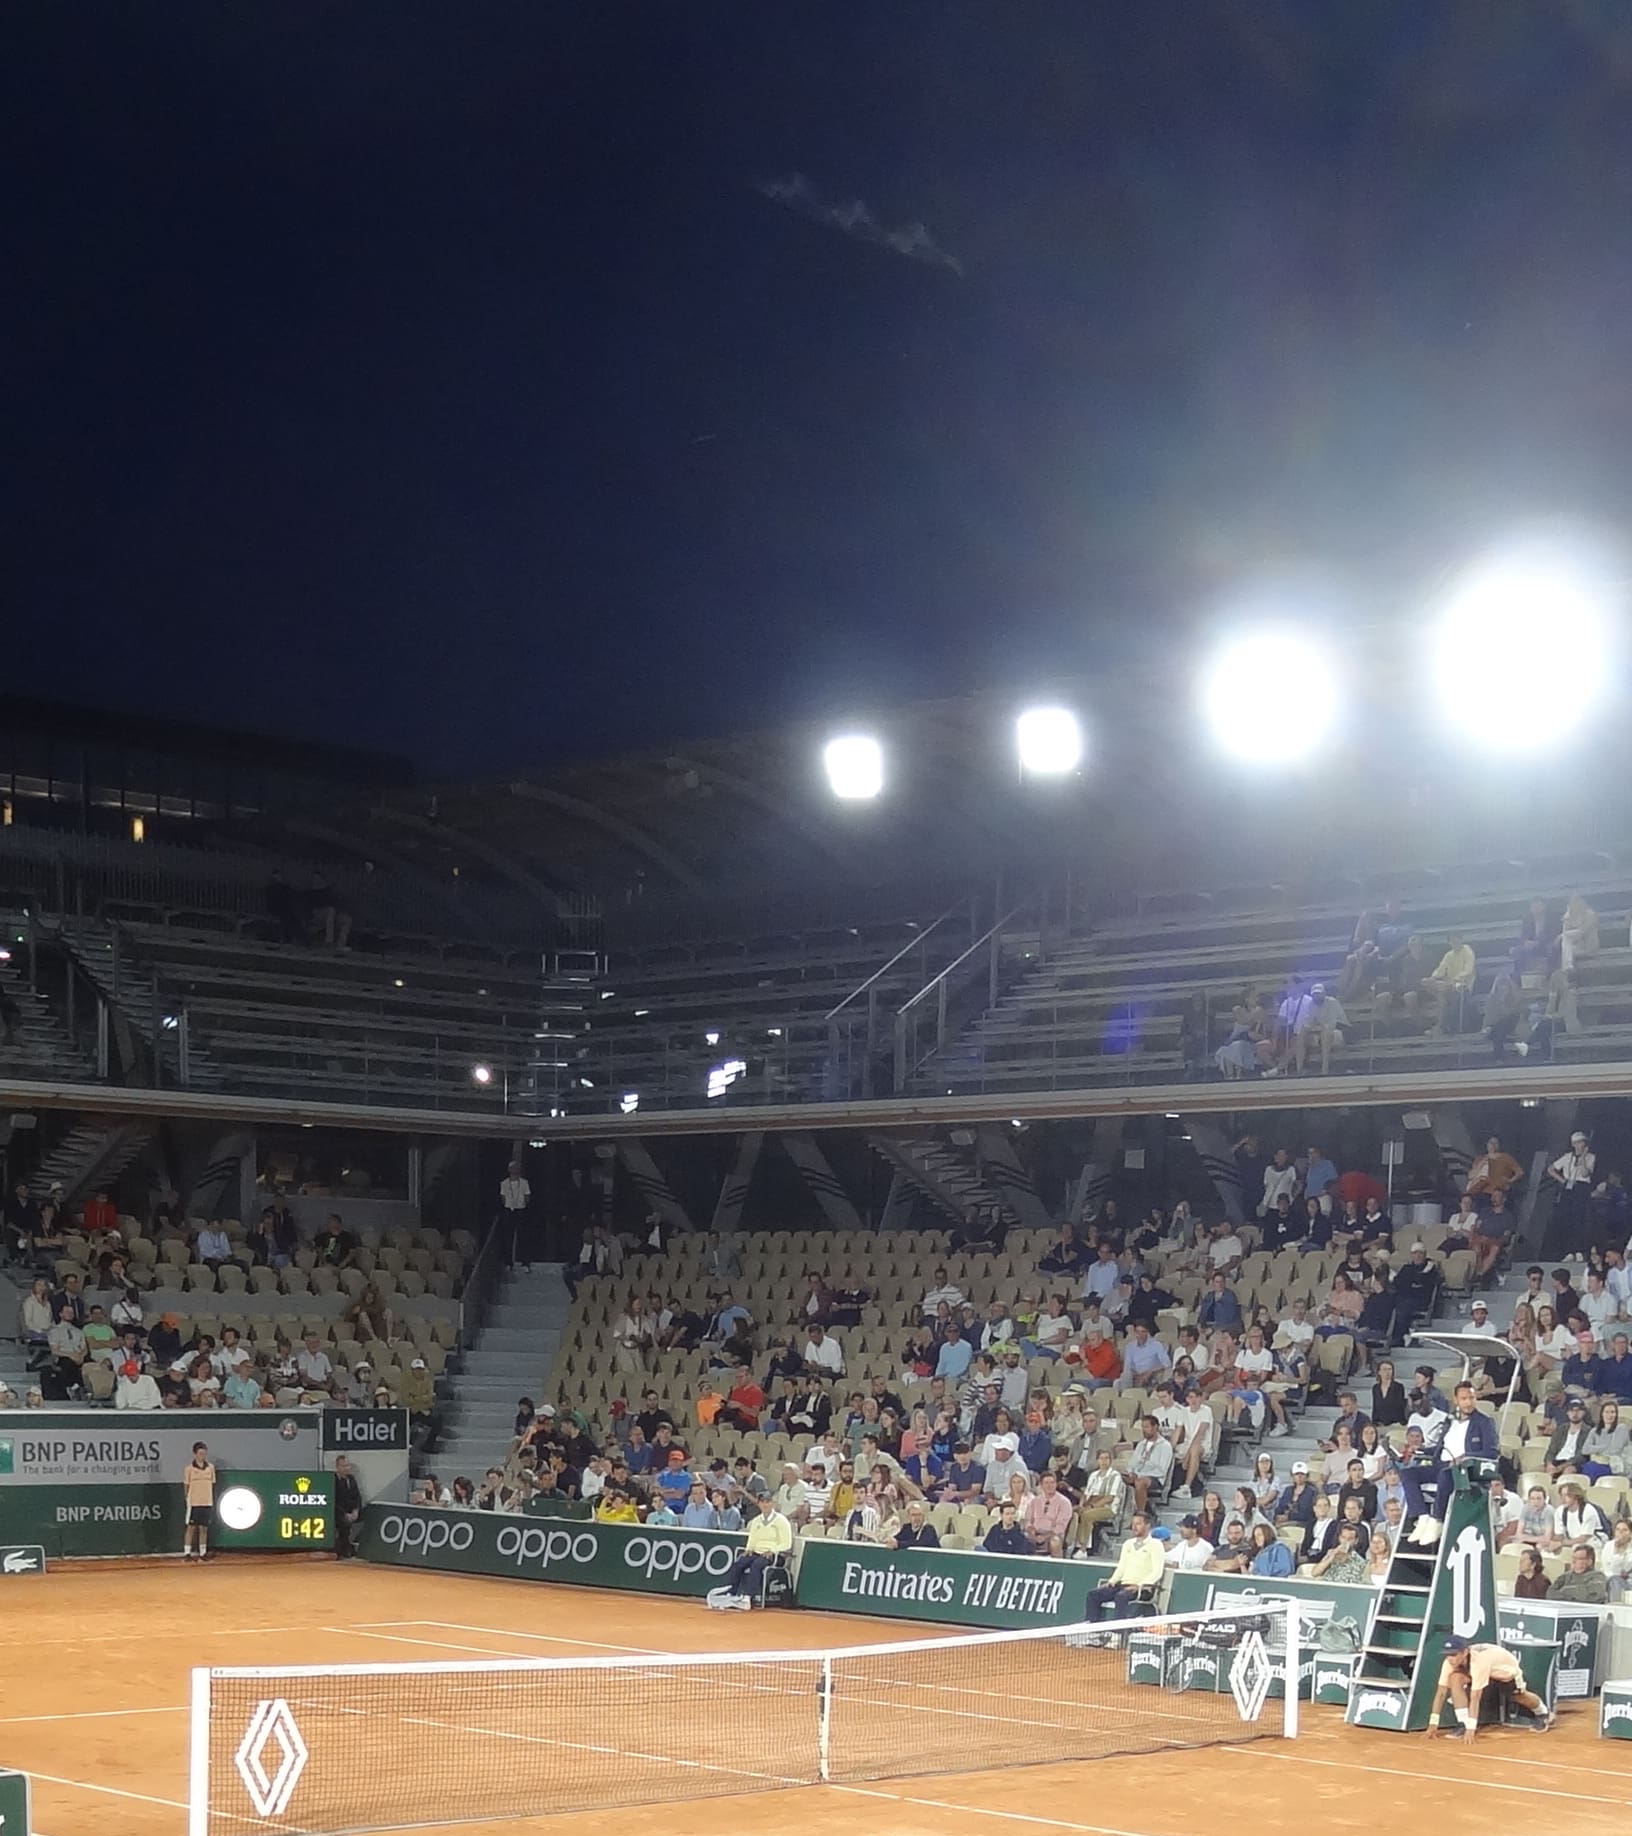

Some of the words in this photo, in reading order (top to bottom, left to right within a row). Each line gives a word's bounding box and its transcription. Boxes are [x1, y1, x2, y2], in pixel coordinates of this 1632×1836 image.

[335, 1416, 398, 1442] Haier
[22, 1442, 66, 1462] BNP
[72, 1441, 161, 1462] PARIBAS
[23, 1465, 39, 1475] The
[91, 1464, 131, 1475] changing
[279, 1494, 327, 1506] ROLEX
[56, 1506, 90, 1522] BNP
[94, 1505, 162, 1522] PARIBAS
[281, 1517, 325, 1539] 0:42
[380, 1515, 474, 1556] oppo
[496, 1525, 598, 1568] oppo
[624, 1536, 737, 1581] oppo
[841, 1563, 954, 1603] Emirates
[963, 1575, 996, 1607] FLY
[996, 1577, 1064, 1615] BETTER
